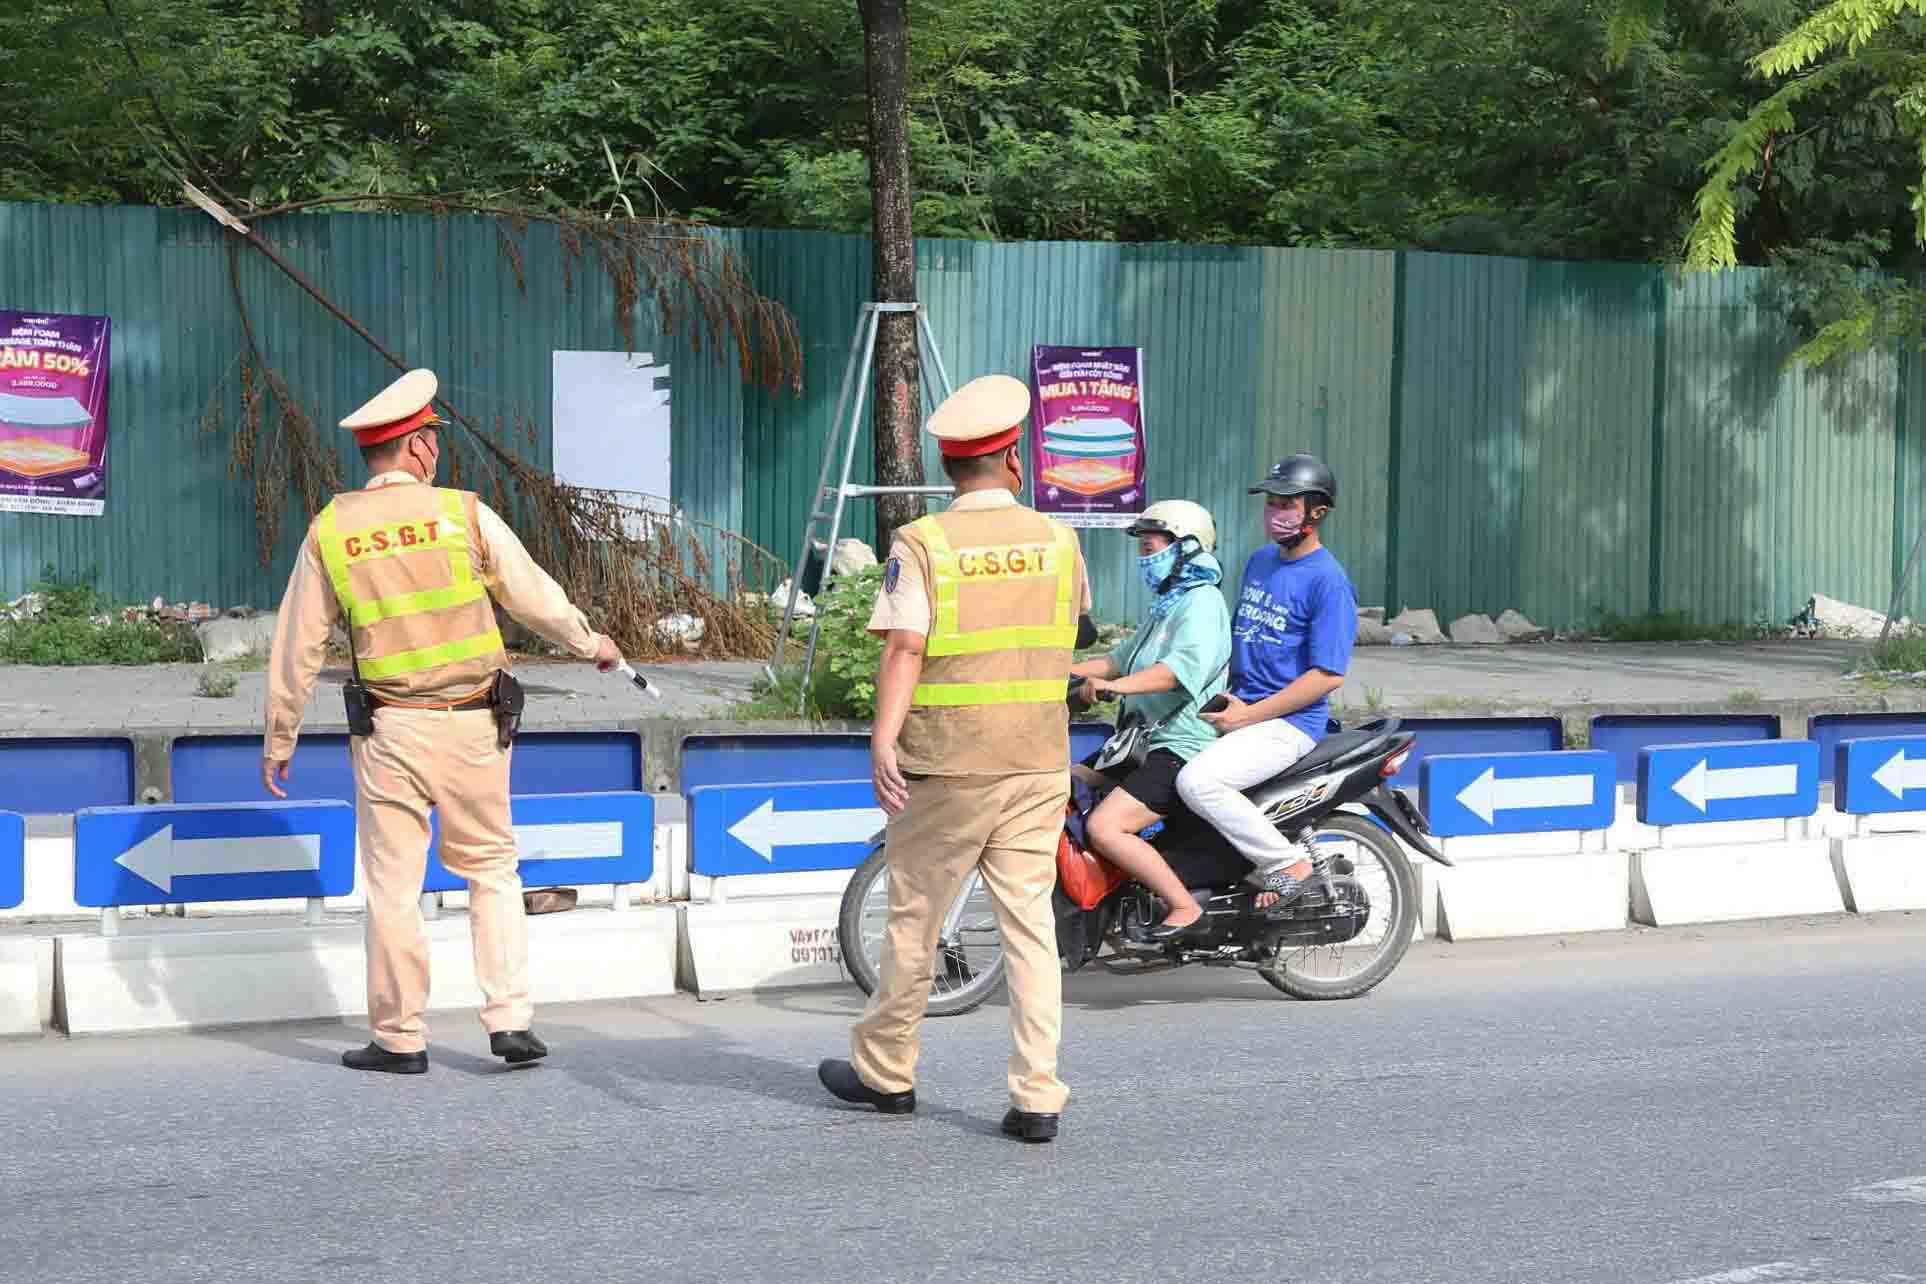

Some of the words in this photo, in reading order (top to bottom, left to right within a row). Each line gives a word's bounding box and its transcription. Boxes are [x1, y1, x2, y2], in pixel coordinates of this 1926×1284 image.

[43, 352, 91, 376] 50%
[1040, 382, 1078, 400] MUA
[1079, 381, 1088, 396] 1
[345, 521, 439, 557] C.S.G.T
[959, 548, 1047, 577] C.S.G.T
